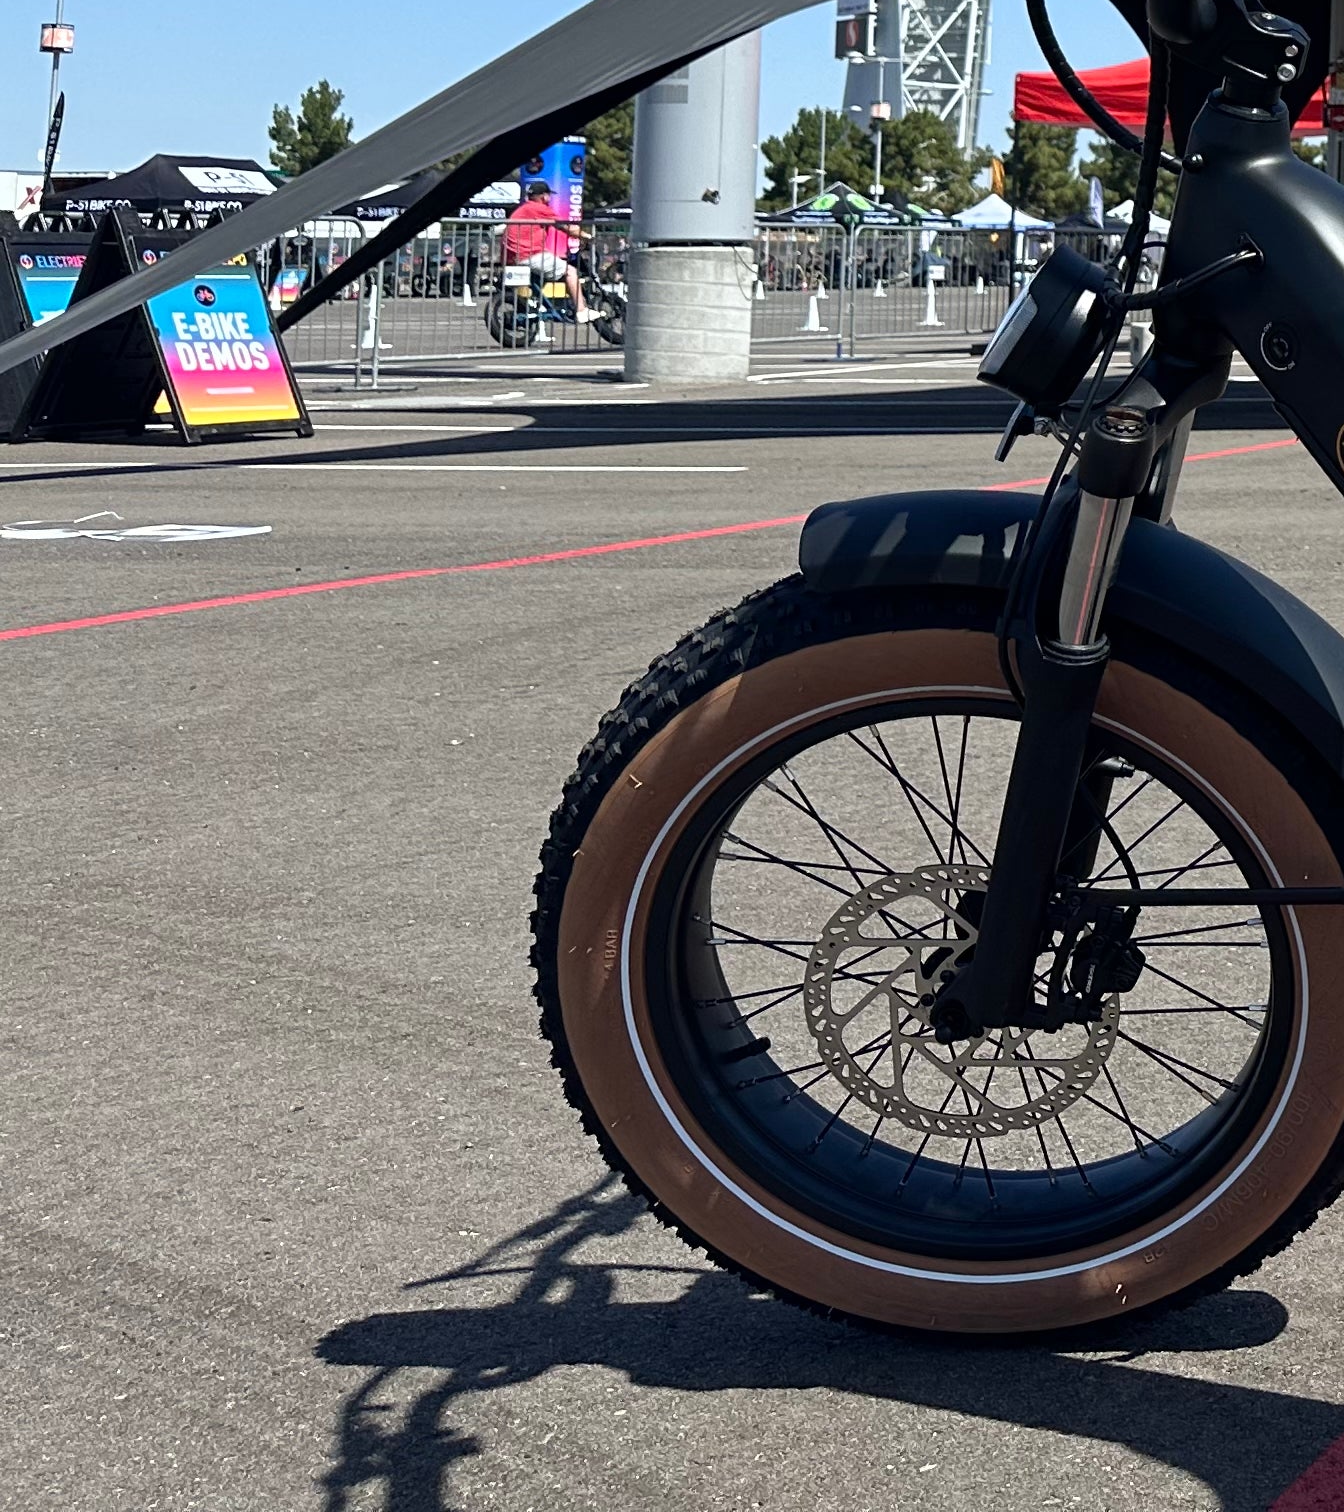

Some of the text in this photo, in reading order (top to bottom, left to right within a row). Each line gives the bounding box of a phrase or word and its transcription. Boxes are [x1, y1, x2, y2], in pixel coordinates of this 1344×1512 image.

[204, 170, 256, 187] P-51
[66, 200, 90, 211] P-51
[184, 200, 205, 212] P-51
[172, 311, 254, 340] E-BIKE
[175, 341, 270, 371] DEMOS
